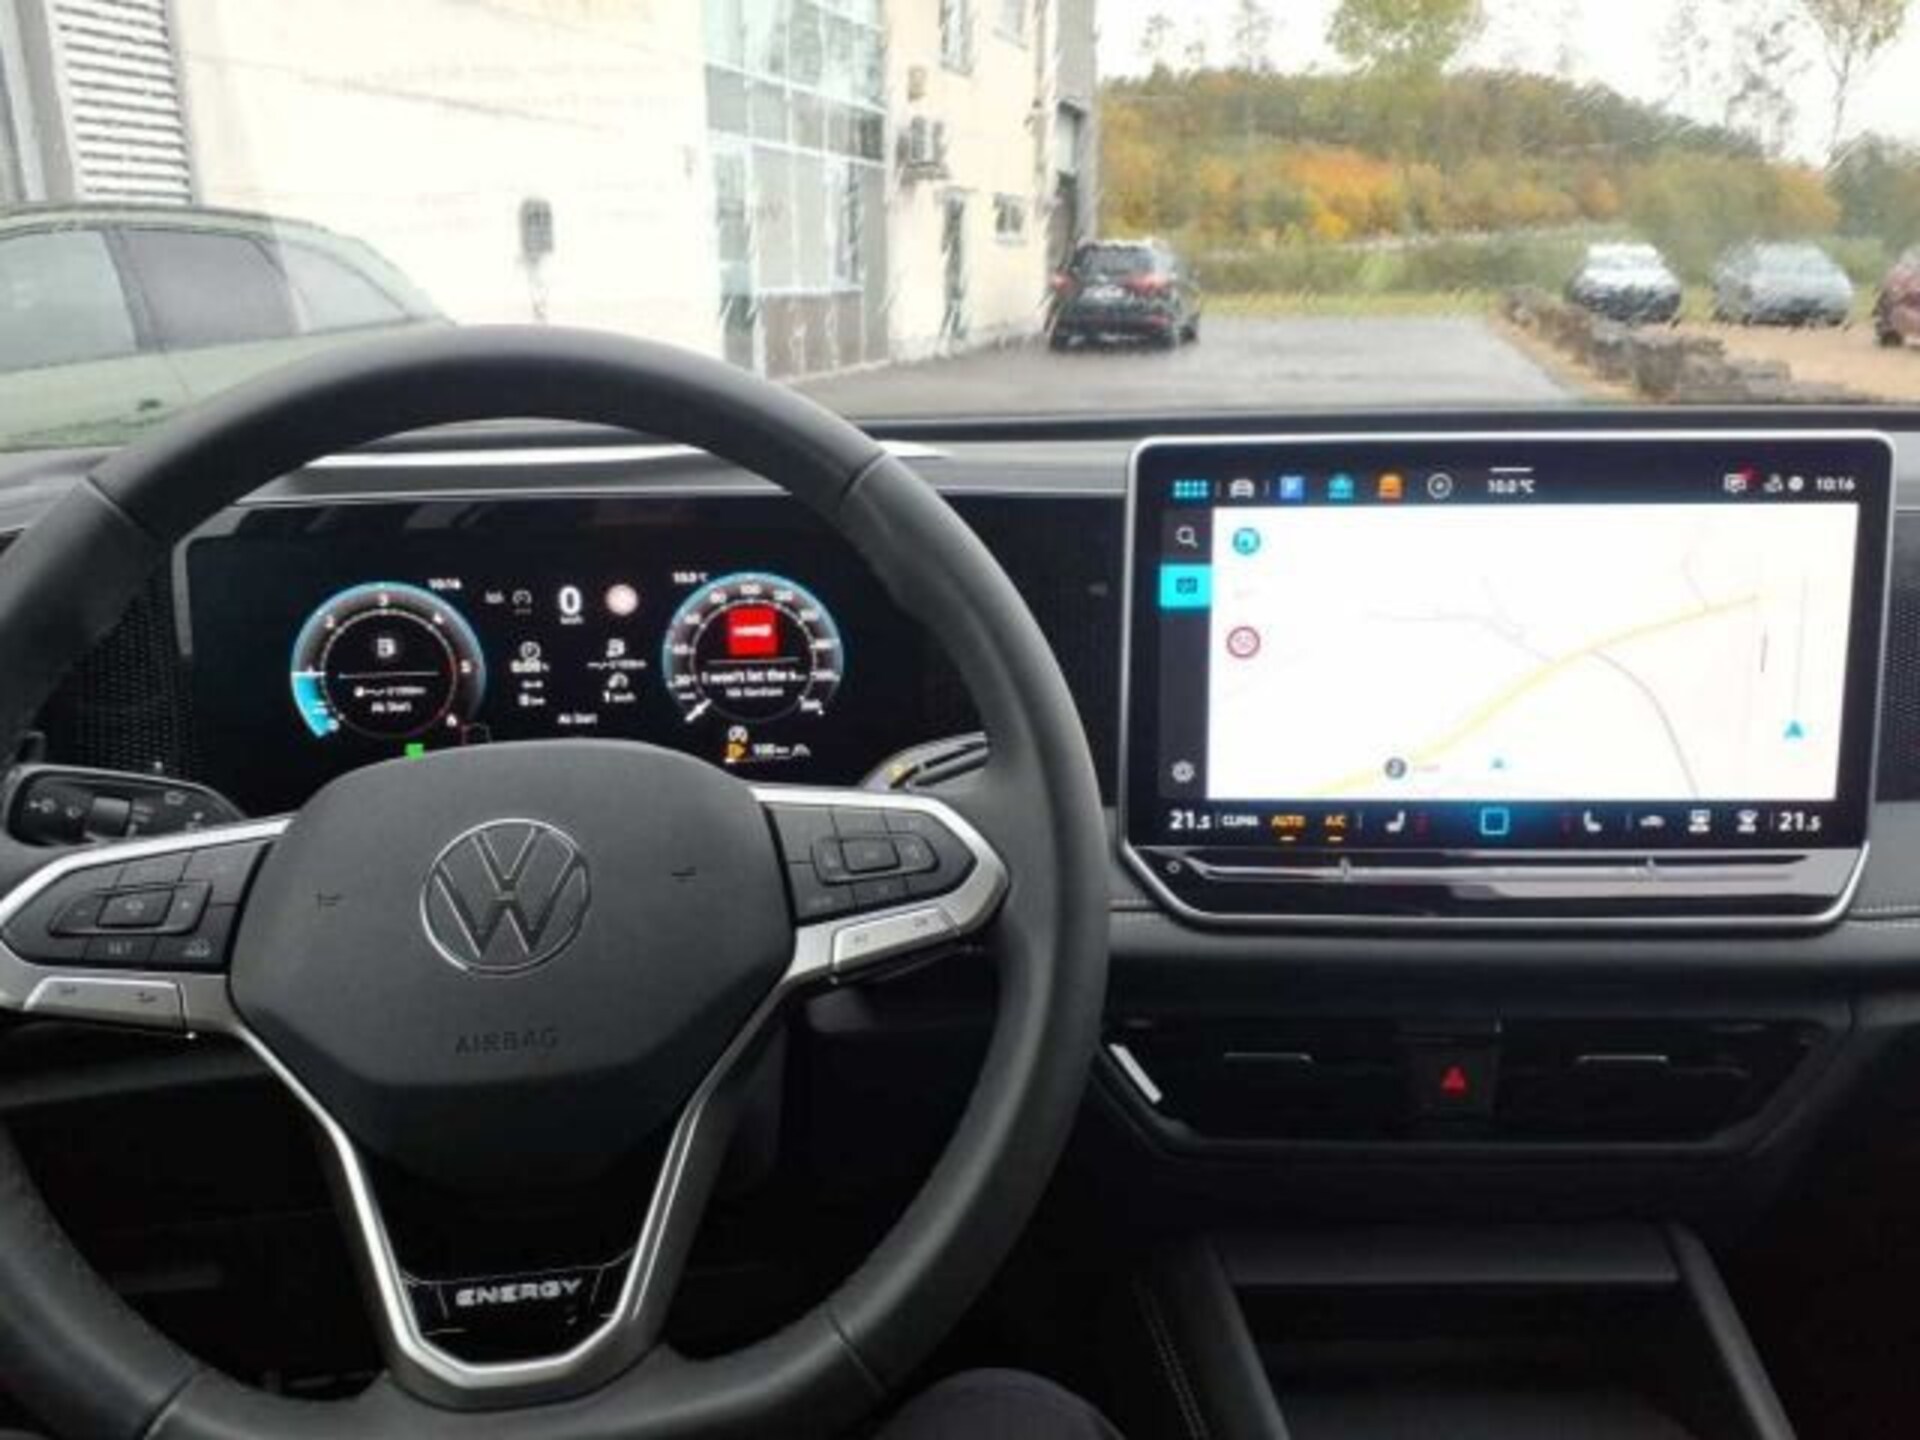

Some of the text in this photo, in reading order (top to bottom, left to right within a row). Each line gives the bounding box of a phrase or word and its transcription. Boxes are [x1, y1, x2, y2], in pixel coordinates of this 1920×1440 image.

[1816, 478, 1855, 491] 10:16
[559, 585, 582, 616] 0
[455, 1027, 558, 1055] AIRBAG
[455, 1278, 583, 1307] ENERGY
